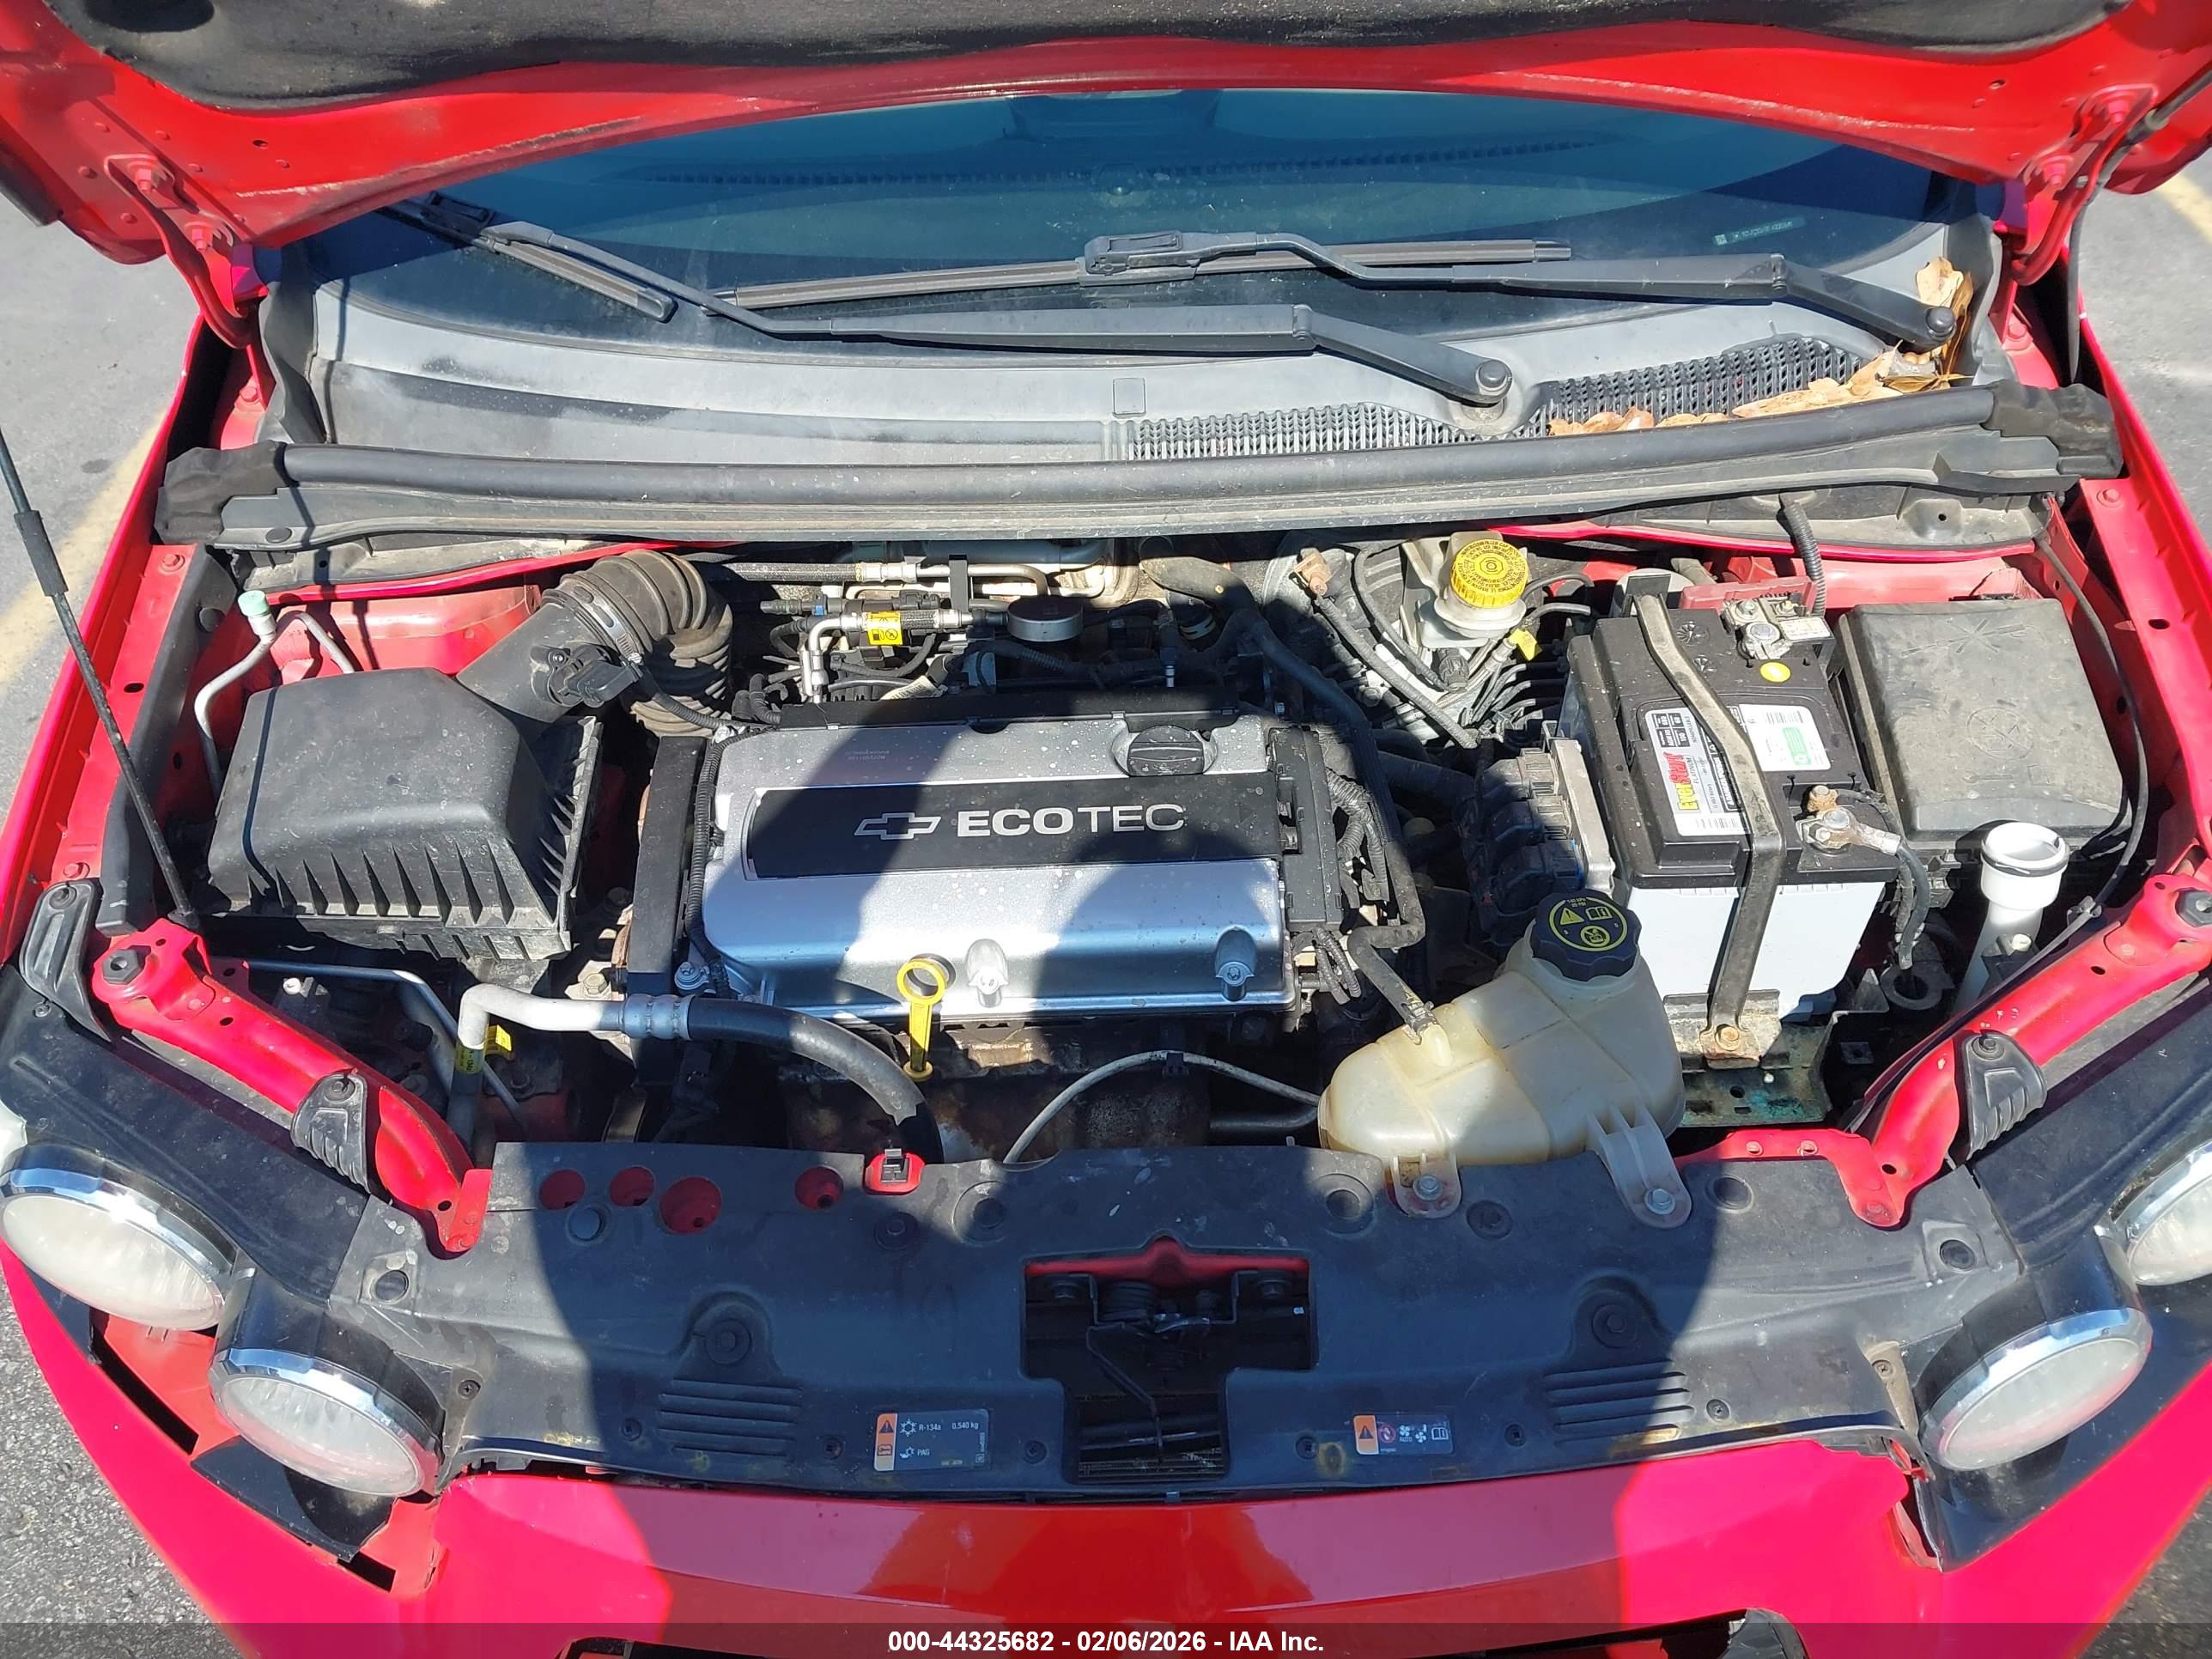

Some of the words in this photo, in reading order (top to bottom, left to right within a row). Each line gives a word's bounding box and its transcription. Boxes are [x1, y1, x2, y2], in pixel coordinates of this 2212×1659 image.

[1662, 751, 1699, 811] EverStart
[1686, 757, 1699, 784] PLATINUM
[957, 804, 1185, 837] ECOTEC
[951, 1421, 969, 1430] 0.540
[970, 1421, 979, 1431] kg
